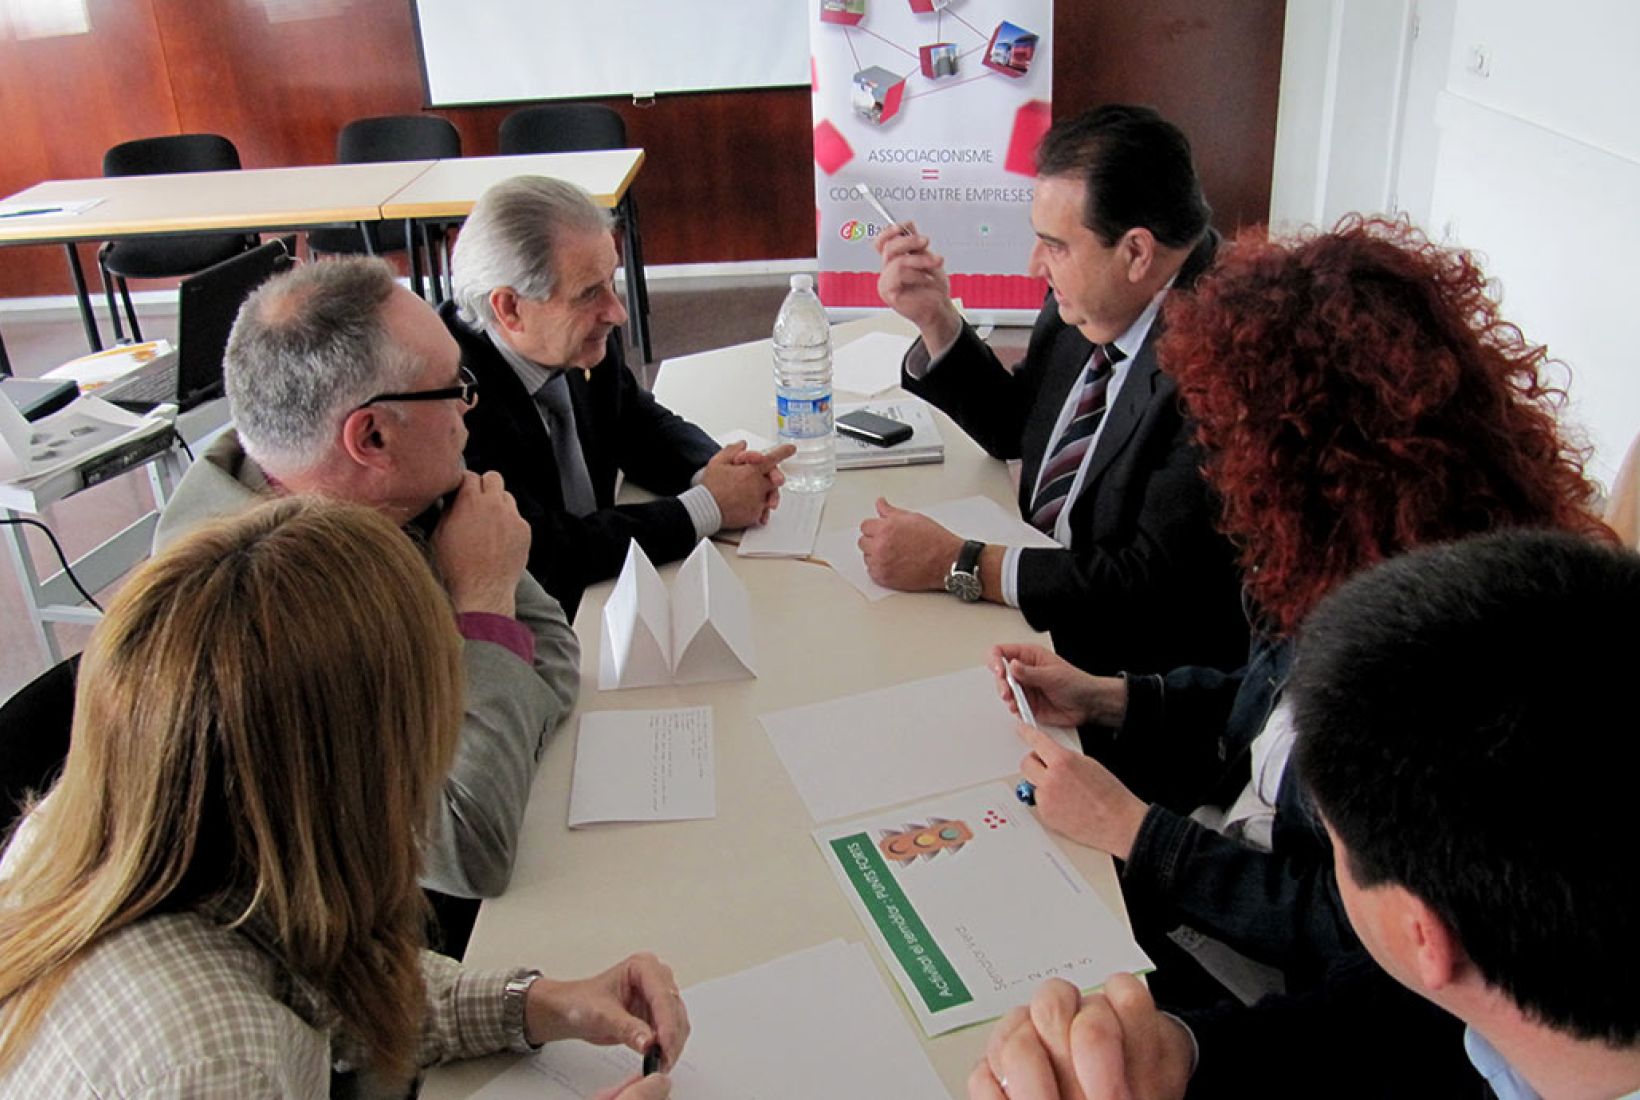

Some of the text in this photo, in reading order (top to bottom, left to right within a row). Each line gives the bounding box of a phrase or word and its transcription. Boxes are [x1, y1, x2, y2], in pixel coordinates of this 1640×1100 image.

[868, 149, 993, 163] ASSOCIACIONISME
[829, 185, 1033, 202] COORACIÓ ENTRE EMPRESES
[847, 842, 872, 871] FORTS
[863, 870, 889, 899] PUNTS
[908, 943, 924, 956] el
[916, 954, 953, 997] Activitat
